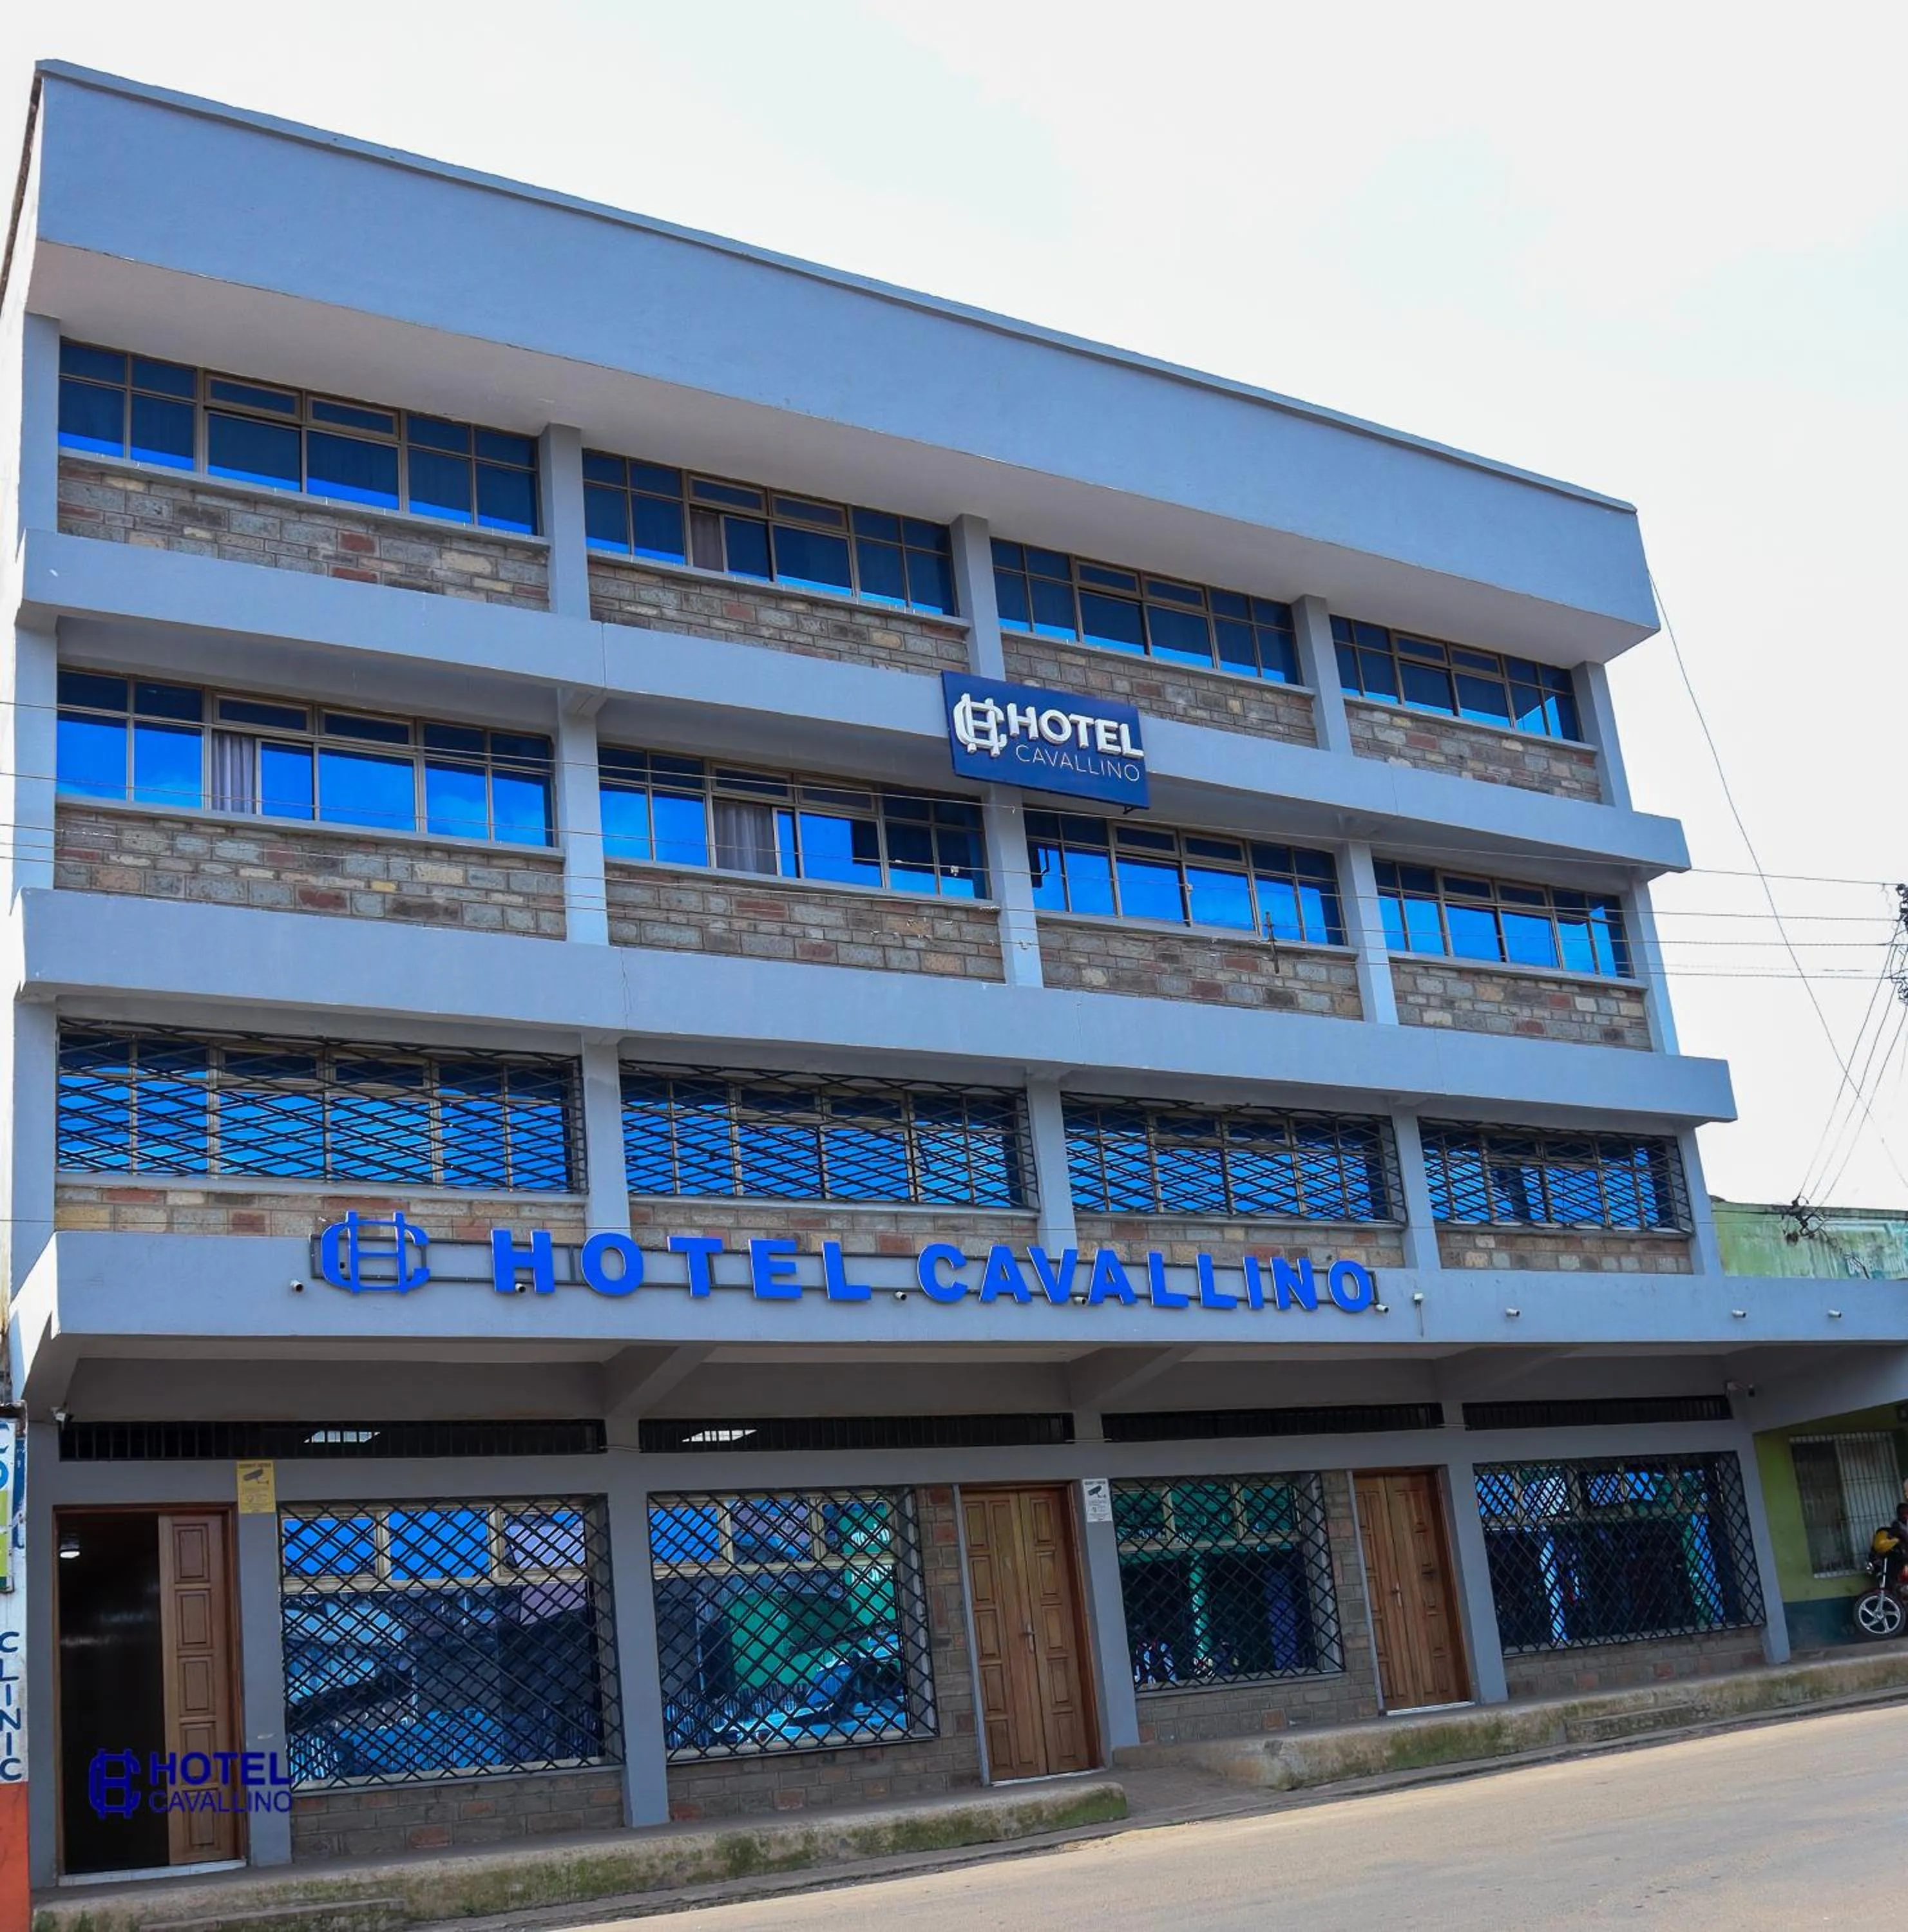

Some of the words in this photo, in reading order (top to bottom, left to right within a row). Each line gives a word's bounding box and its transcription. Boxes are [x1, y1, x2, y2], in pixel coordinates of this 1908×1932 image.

[1007, 703, 1144, 759] HOTEL
[1016, 744, 1140, 781] CAVALLINO
[491, 1229, 870, 1301] HOTEL
[917, 1244, 1374, 1313] CAVALLINO
[0, 1631, 22, 1781] CLINIC
